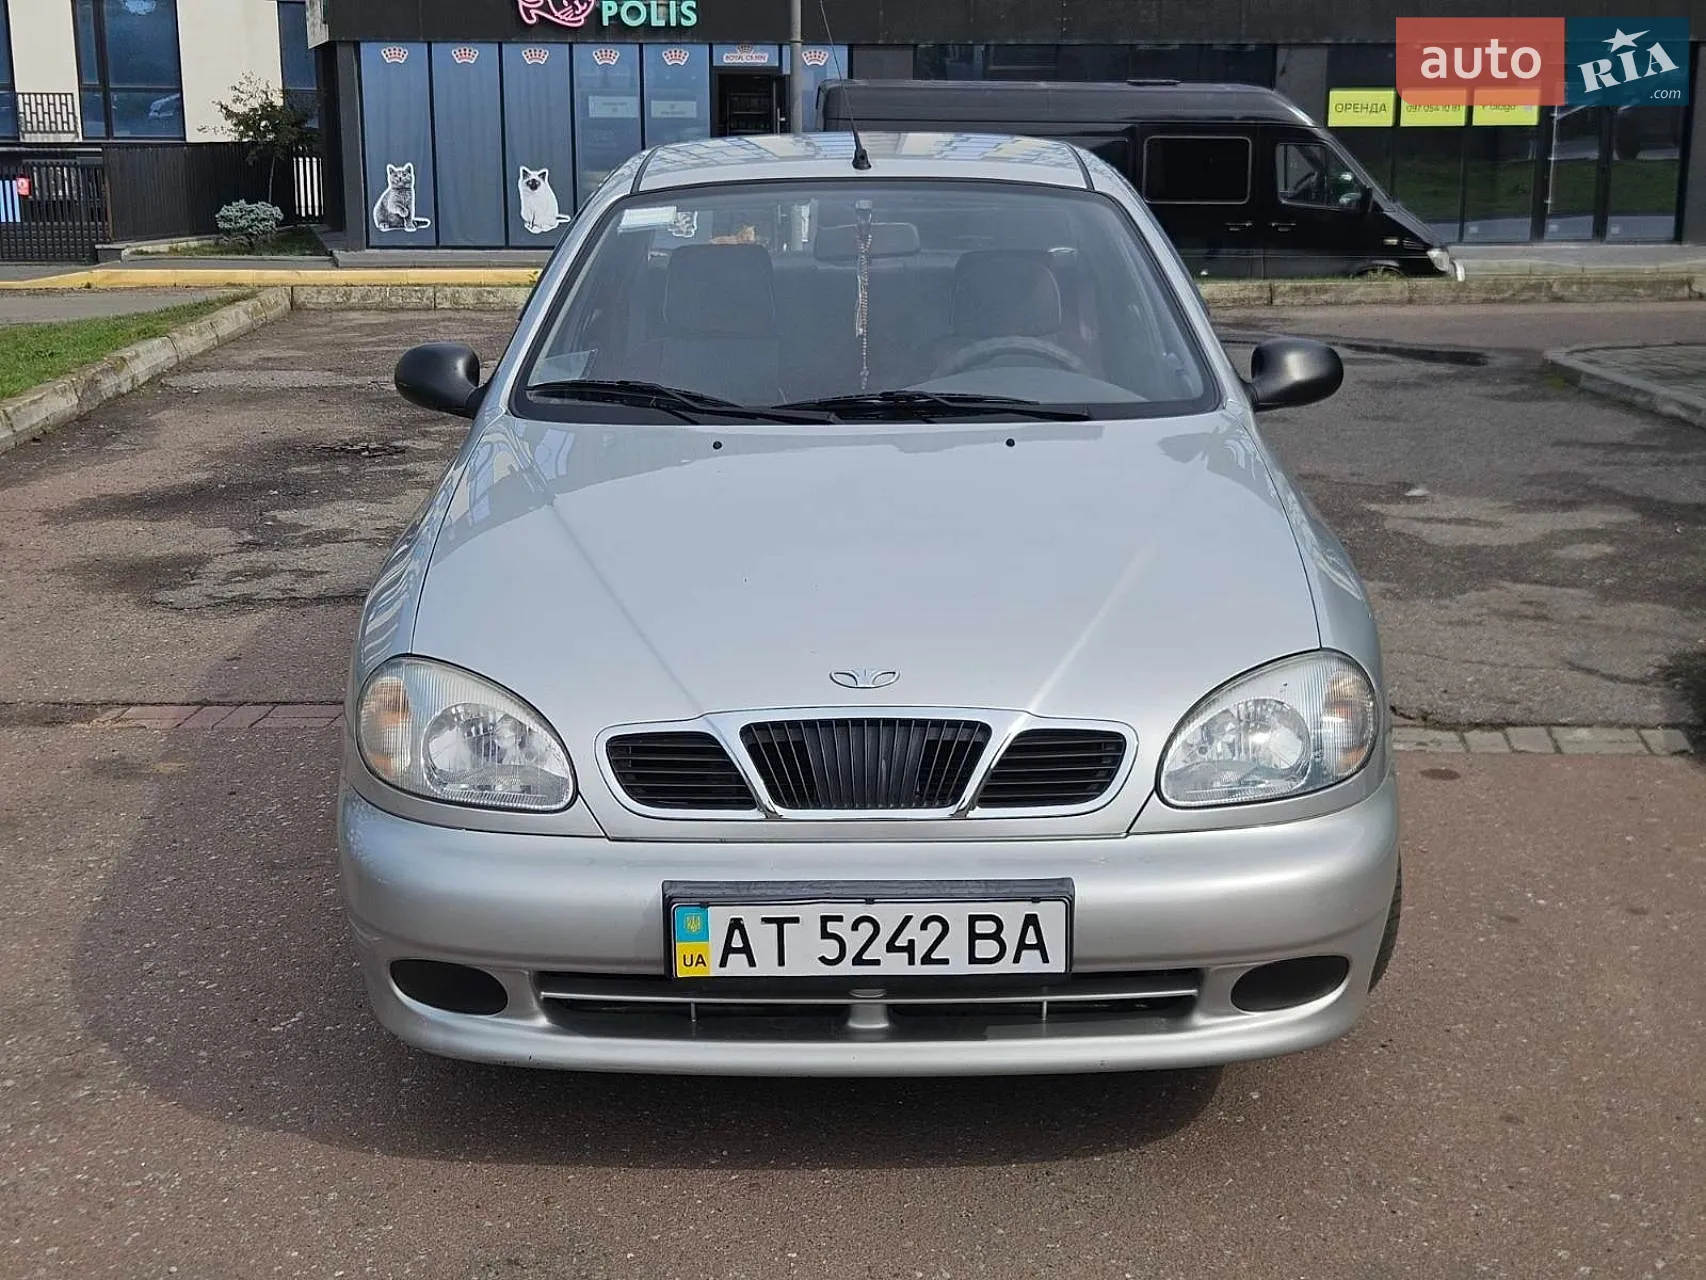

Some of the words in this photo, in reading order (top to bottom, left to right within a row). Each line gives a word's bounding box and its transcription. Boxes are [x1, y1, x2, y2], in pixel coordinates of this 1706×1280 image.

[602, 0, 698, 26] POLIS
[1334, 103, 1388, 114] ОРЕНДА
[718, 916, 801, 968] AT
[817, 914, 951, 967] 5242
[967, 913, 1050, 965] BA
[682, 953, 707, 968] UA
